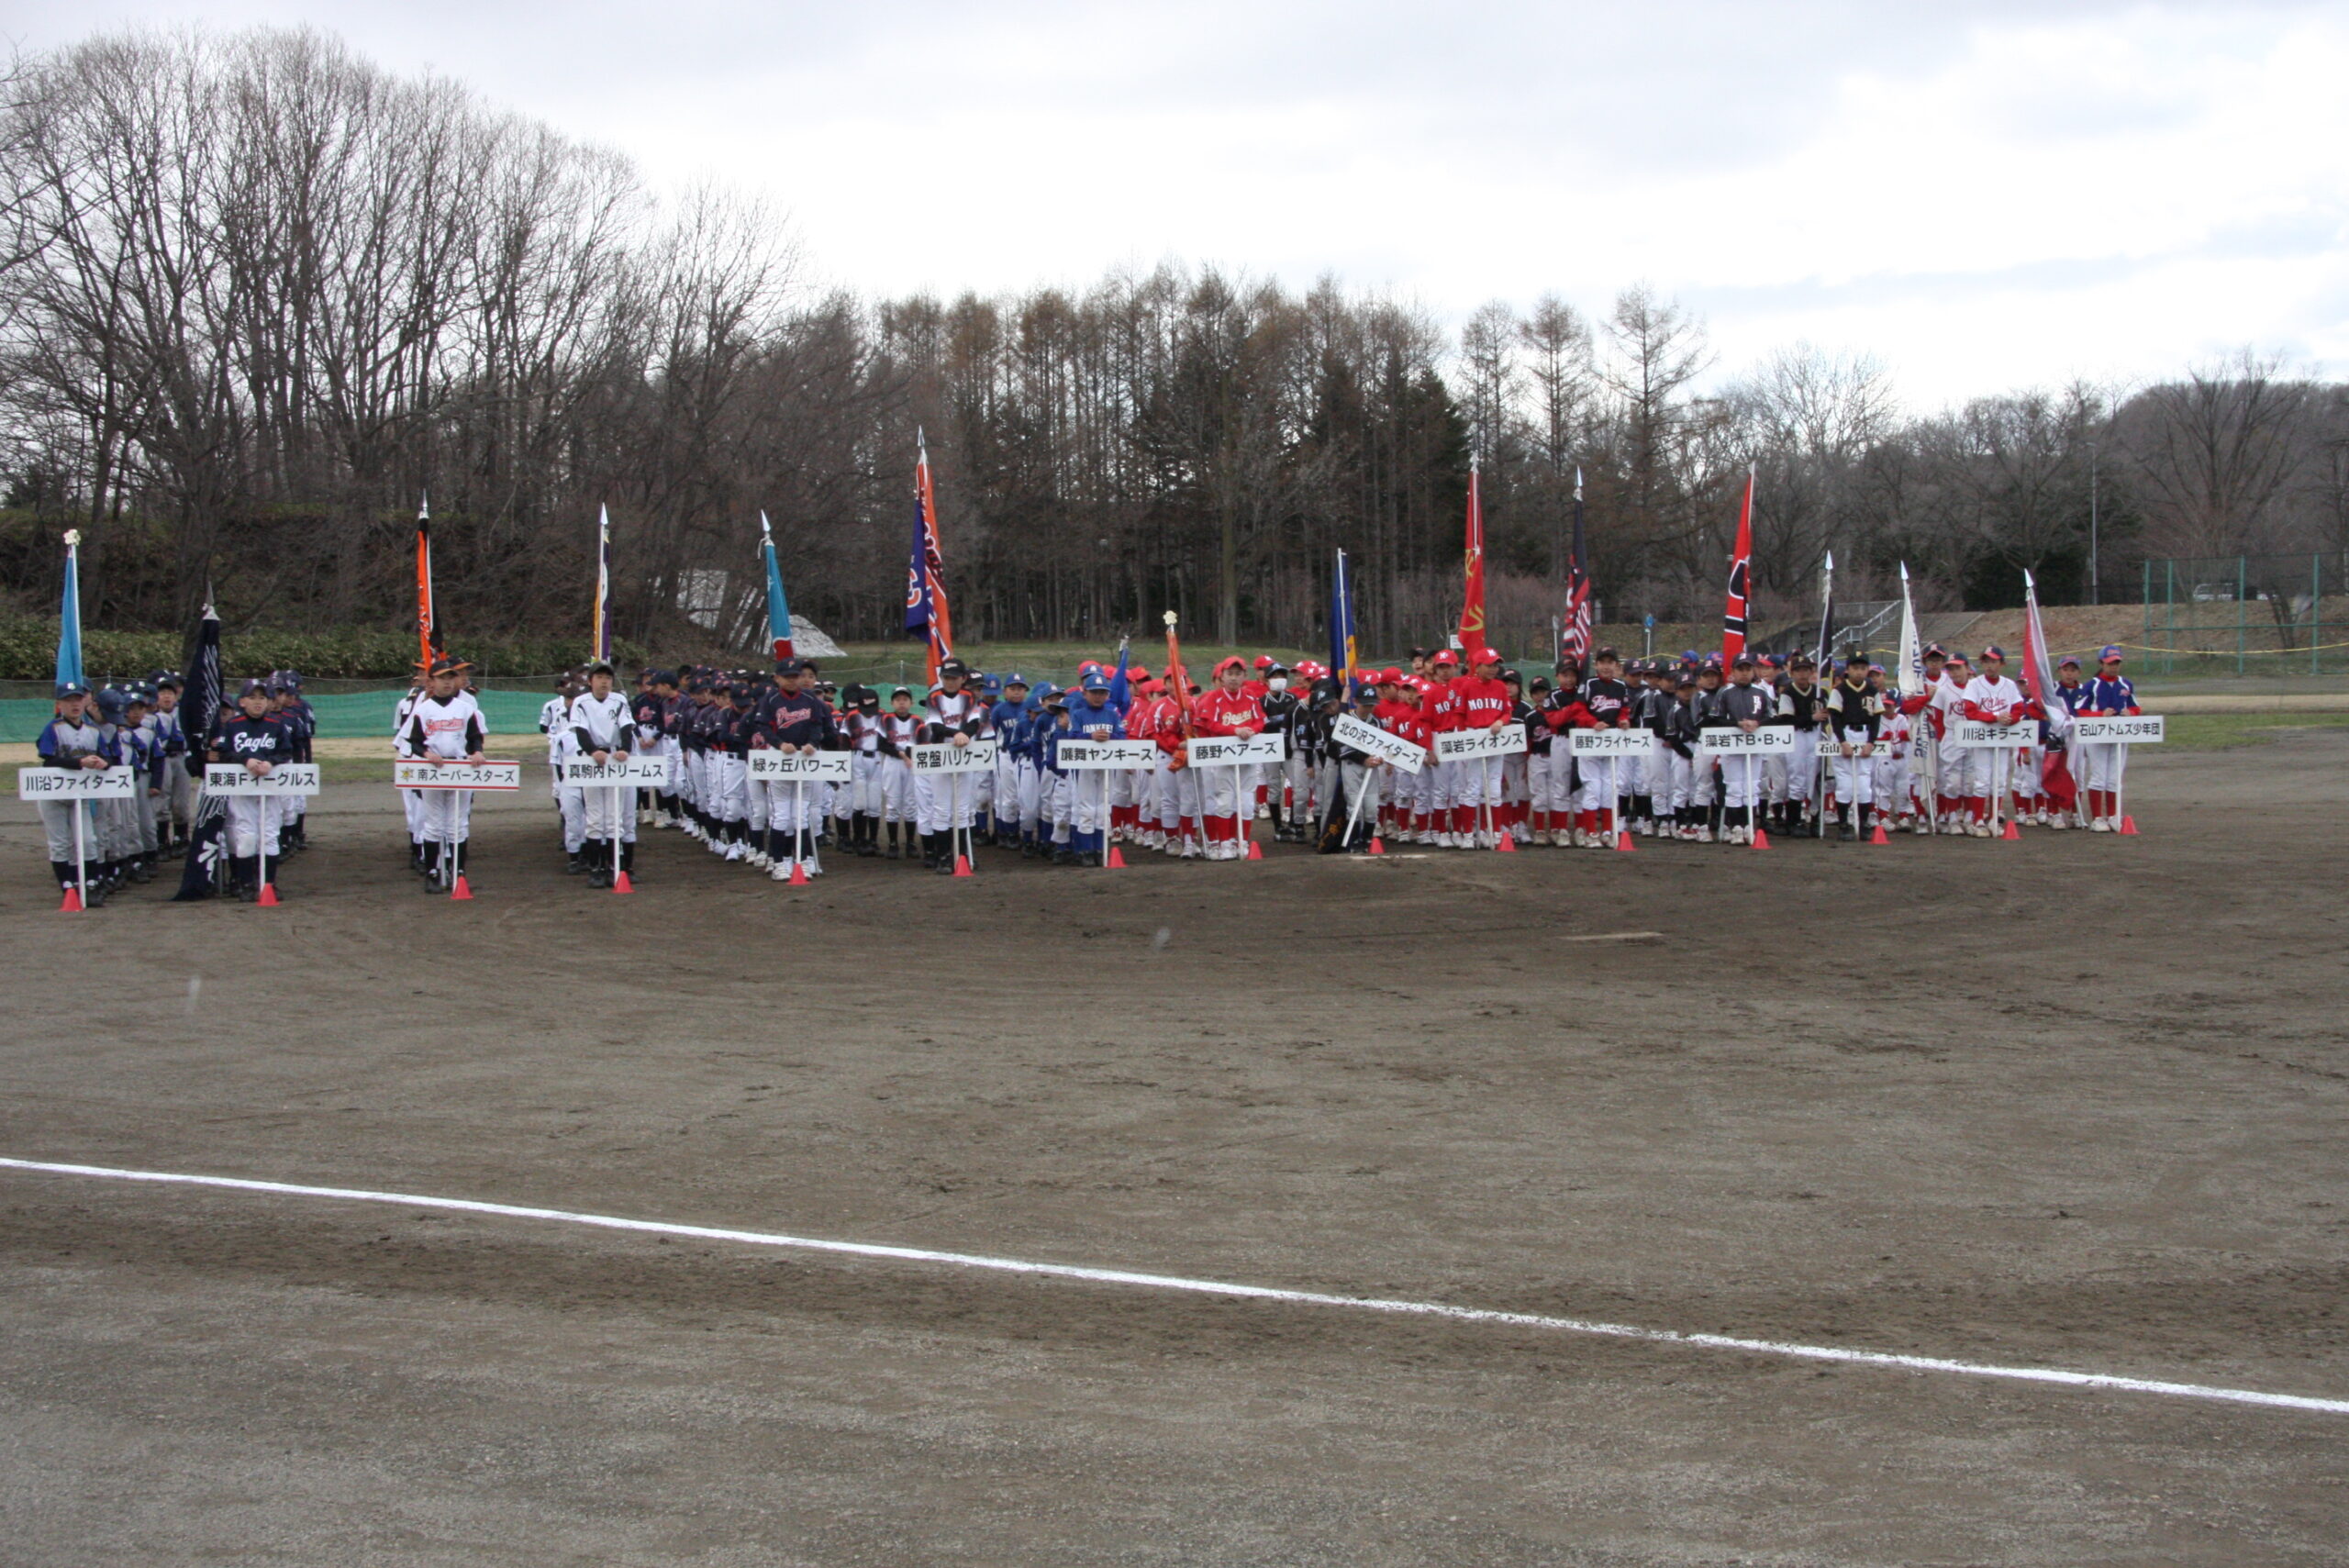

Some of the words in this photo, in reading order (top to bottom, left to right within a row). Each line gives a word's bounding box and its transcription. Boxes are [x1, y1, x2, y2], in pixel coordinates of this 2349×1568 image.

[1468, 697, 1503, 711] MOIWA
[1962, 728, 2032, 740] 川沿キラーズ
[2079, 723, 2160, 736] 石山アトムズ少年団
[234, 732, 276, 752] Eagles
[26, 774, 129, 791] 川沿ファイターズ
